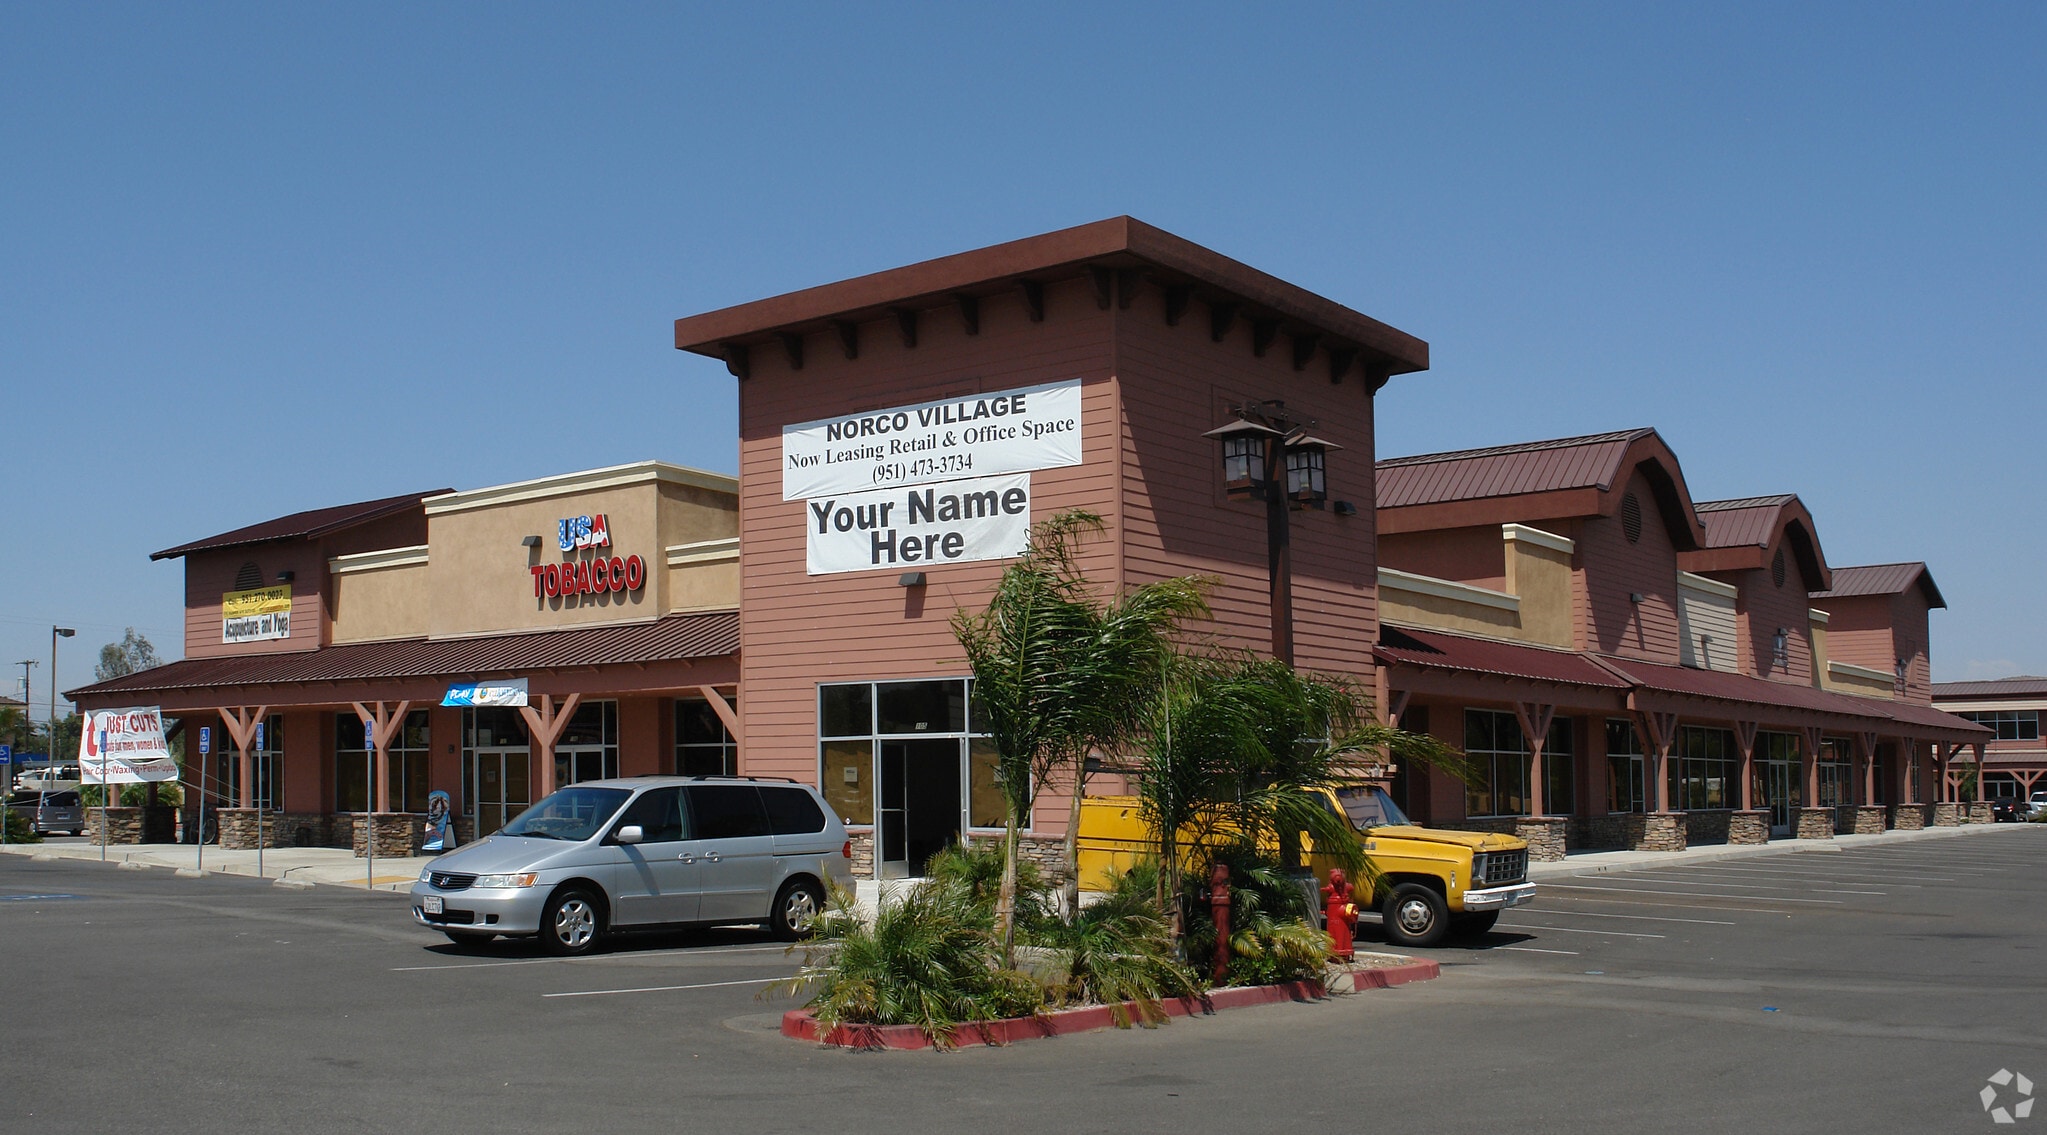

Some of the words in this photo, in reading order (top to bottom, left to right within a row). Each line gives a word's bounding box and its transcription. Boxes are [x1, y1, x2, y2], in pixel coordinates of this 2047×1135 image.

[826, 412, 909, 442] NORCO
[916, 394, 1027, 428] VILLAGE
[788, 453, 821, 470] Now
[826, 443, 885, 465] Leasing
[890, 433, 937, 455] Retail
[942, 430, 957, 448] &
[963, 423, 1017, 445] Office
[1022, 417, 1075, 440] Space
[872, 462, 906, 485] (951)
[910, 453, 973, 477] 473-3734
[810, 499, 895, 535] Your
[908, 486, 1027, 525] Name
[558, 514, 610, 552] USA
[871, 528, 965, 565] Here
[530, 554, 643, 598] TOBACCO
[225, 617, 259, 641] Acupuncture
[261, 613, 272, 634] and
[273, 612, 288, 637] Yoga
[104, 714, 127, 734] JUST
[129, 713, 159, 733] CUTS
